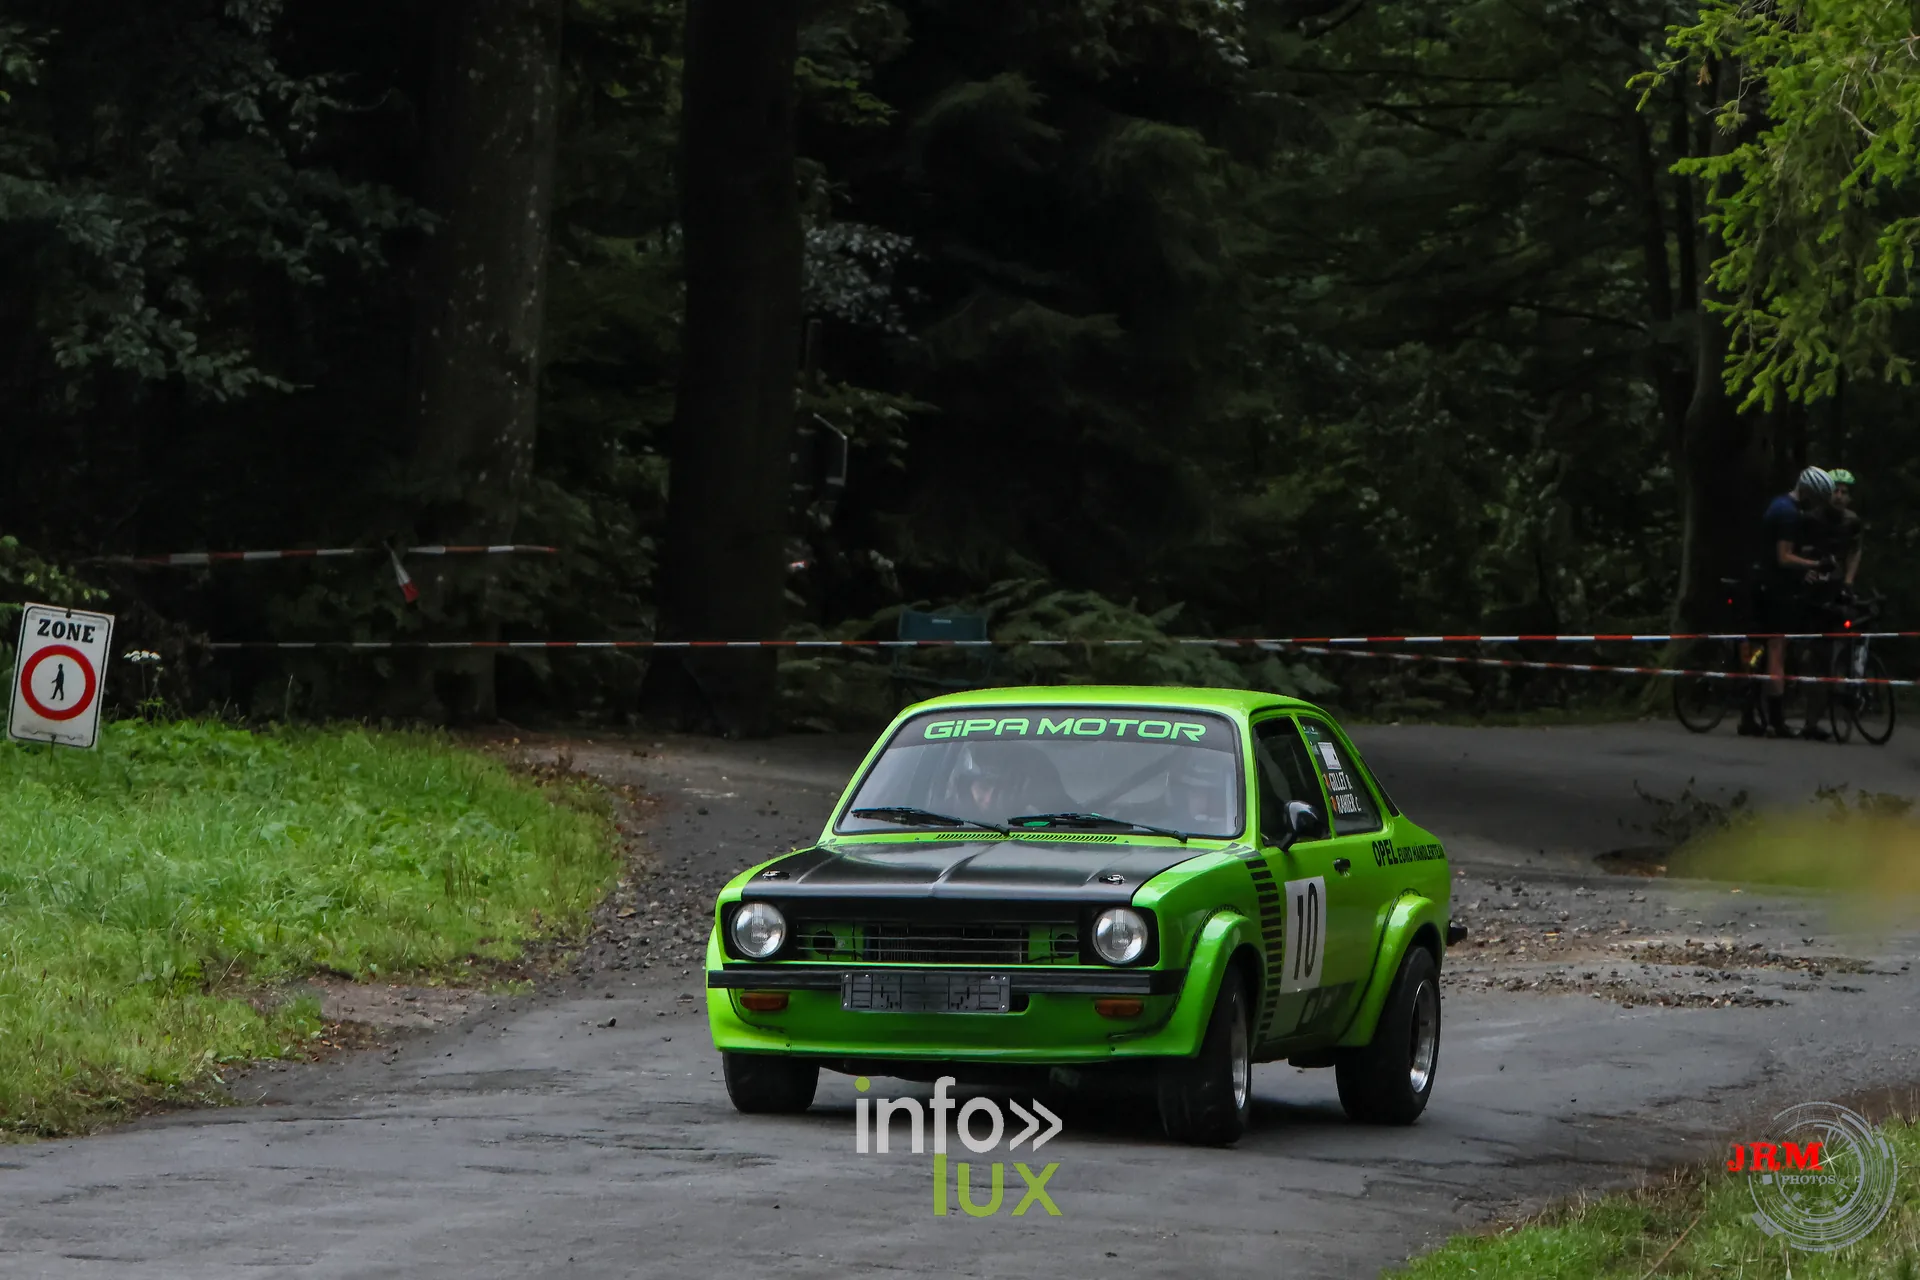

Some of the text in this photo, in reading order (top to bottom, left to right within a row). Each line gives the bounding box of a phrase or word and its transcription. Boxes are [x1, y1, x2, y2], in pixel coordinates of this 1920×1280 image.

[37, 618, 96, 644] ZONE
[1037, 718, 1206, 742] MOTOR
[1372, 839, 1398, 868] OPEL
[1294, 882, 1318, 981] 10
